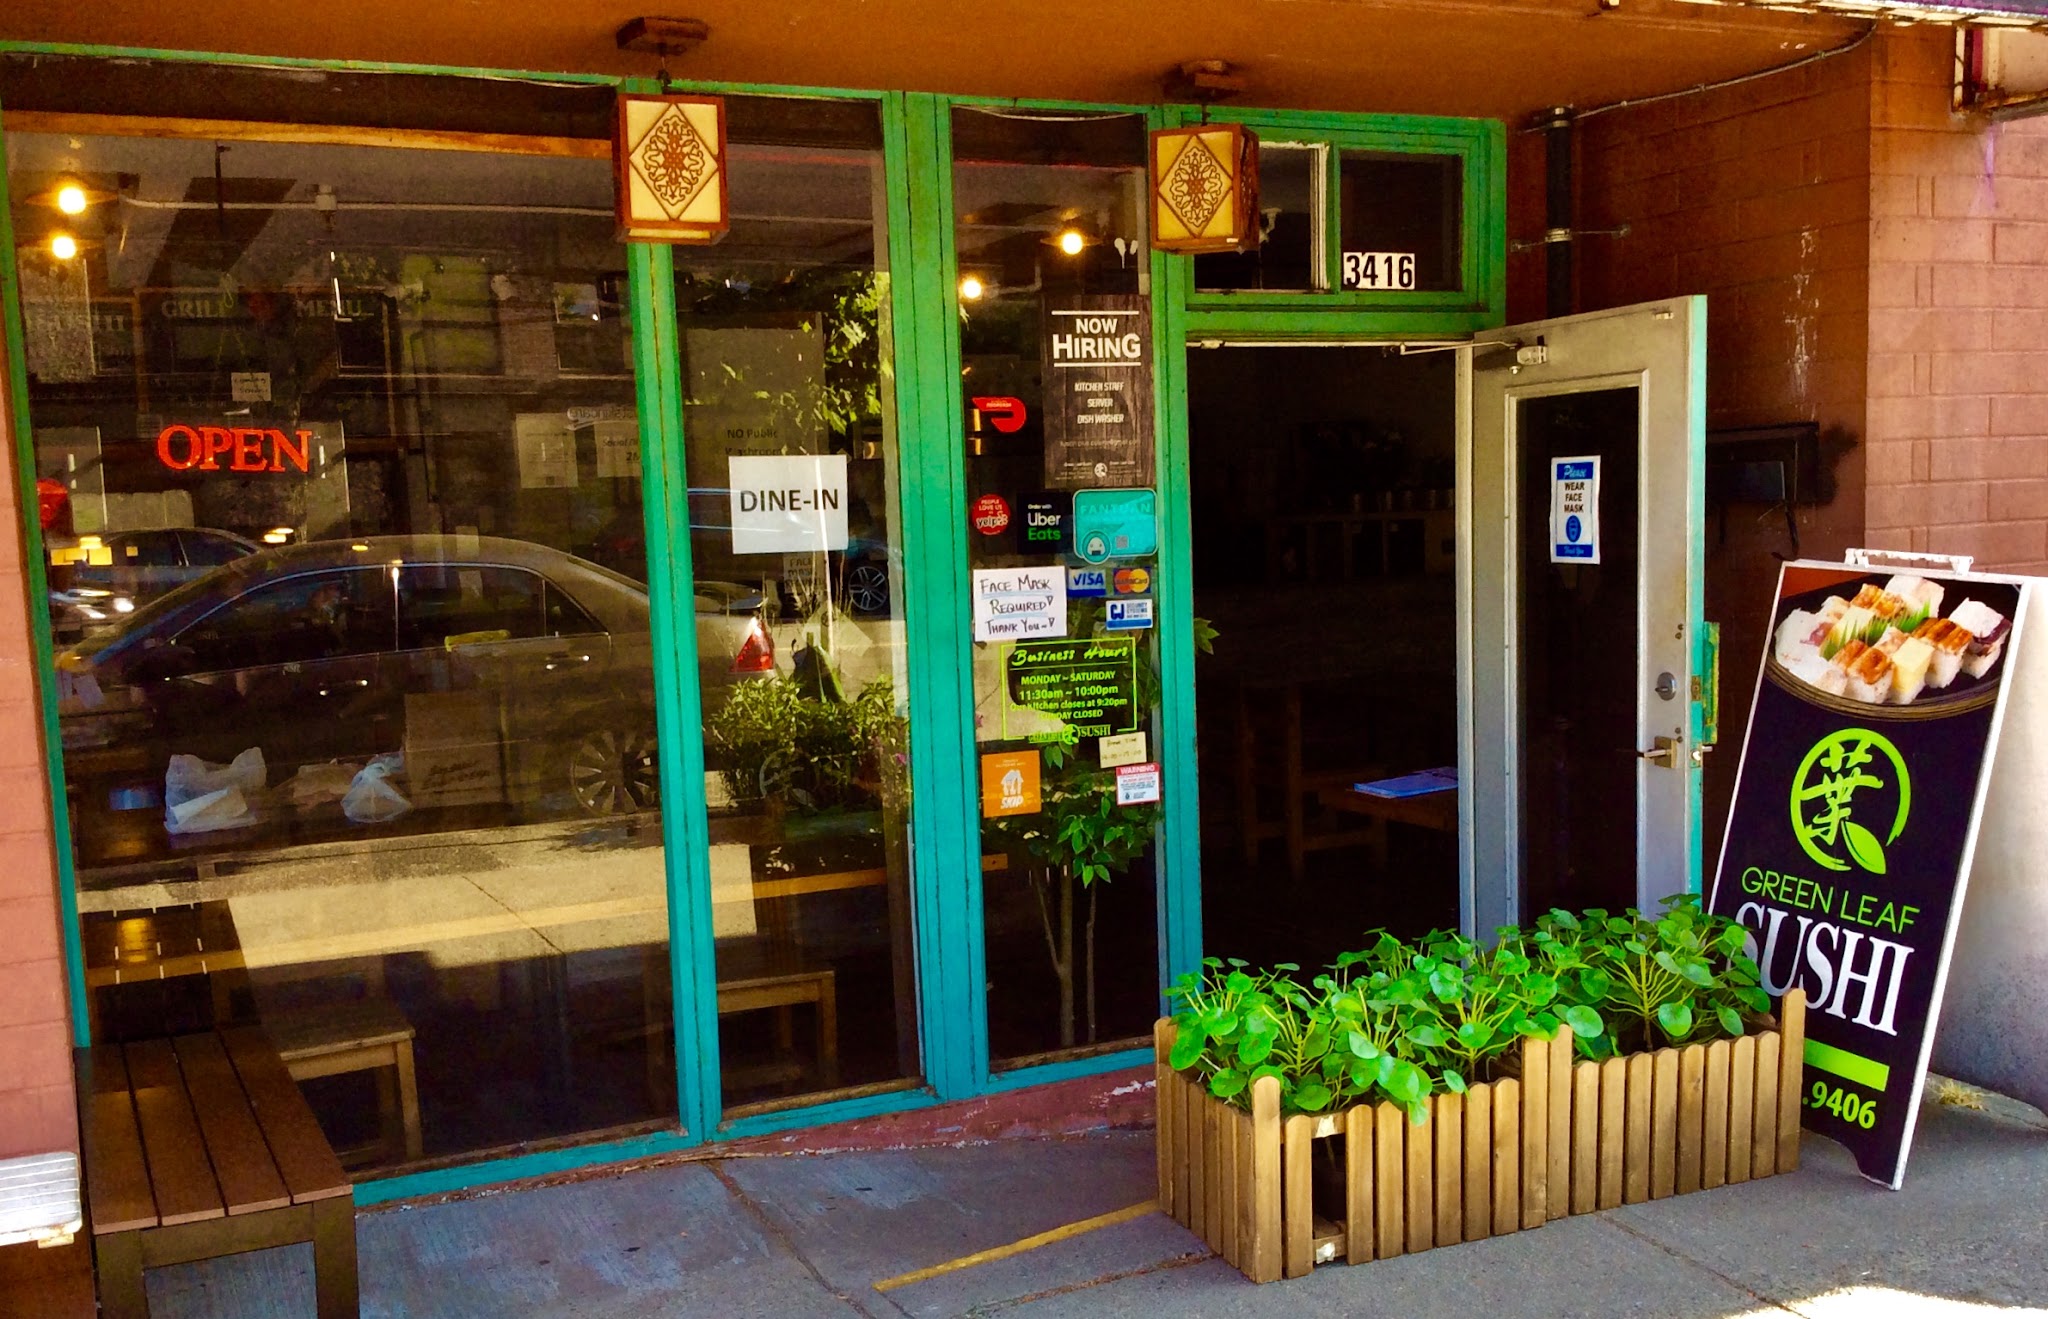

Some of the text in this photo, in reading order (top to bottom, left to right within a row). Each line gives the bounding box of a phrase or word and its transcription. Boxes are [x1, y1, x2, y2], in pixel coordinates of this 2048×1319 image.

[1345, 255, 1413, 289] 3416
[1076, 318, 1118, 334] NOW
[1052, 333, 1141, 359] HIRING
[1074, 381, 1124, 392] KITCHEN STAFF
[1087, 398, 1114, 408] SERVER
[1077, 413, 1124, 424] DISH WASHER
[727, 428, 778, 438] NO Public
[156, 423, 313, 473] OPEN
[1563, 464, 1587, 479] Please
[1564, 482, 1585, 491] WEAR
[740, 488, 839, 512] DINE-IN
[1565, 493, 1583, 502] FACE
[1564, 504, 1584, 513] MASK
[976, 515, 998, 529] yelp
[1027, 512, 1061, 526] Uber
[1028, 527, 1061, 541] Eats
[980, 578, 1012, 593] FACE
[1073, 572, 1104, 586] VISA
[989, 598, 1047, 615] REQUIRED
[1011, 646, 1129, 667] Business Hours
[1021, 674, 1062, 686] MONDAY
[1070, 671, 1116, 682] SATURDAY
[1019, 688, 1063, 701] 11:30am
[1075, 685, 1119, 697] 10:00pm
[1061, 699, 1085, 709] closes
[1086, 700, 1095, 708] at
[1096, 697, 1128, 708] 9:20pm
[1073, 709, 1103, 719] CLOSED
[1080, 724, 1112, 738] SUSHI
[1120, 765, 1155, 774] WARNING
[1000, 795, 1024, 809] SKIP
[1742, 866, 1920, 934] GREEN LEAF
[1726, 901, 1915, 1037] SUSHI
